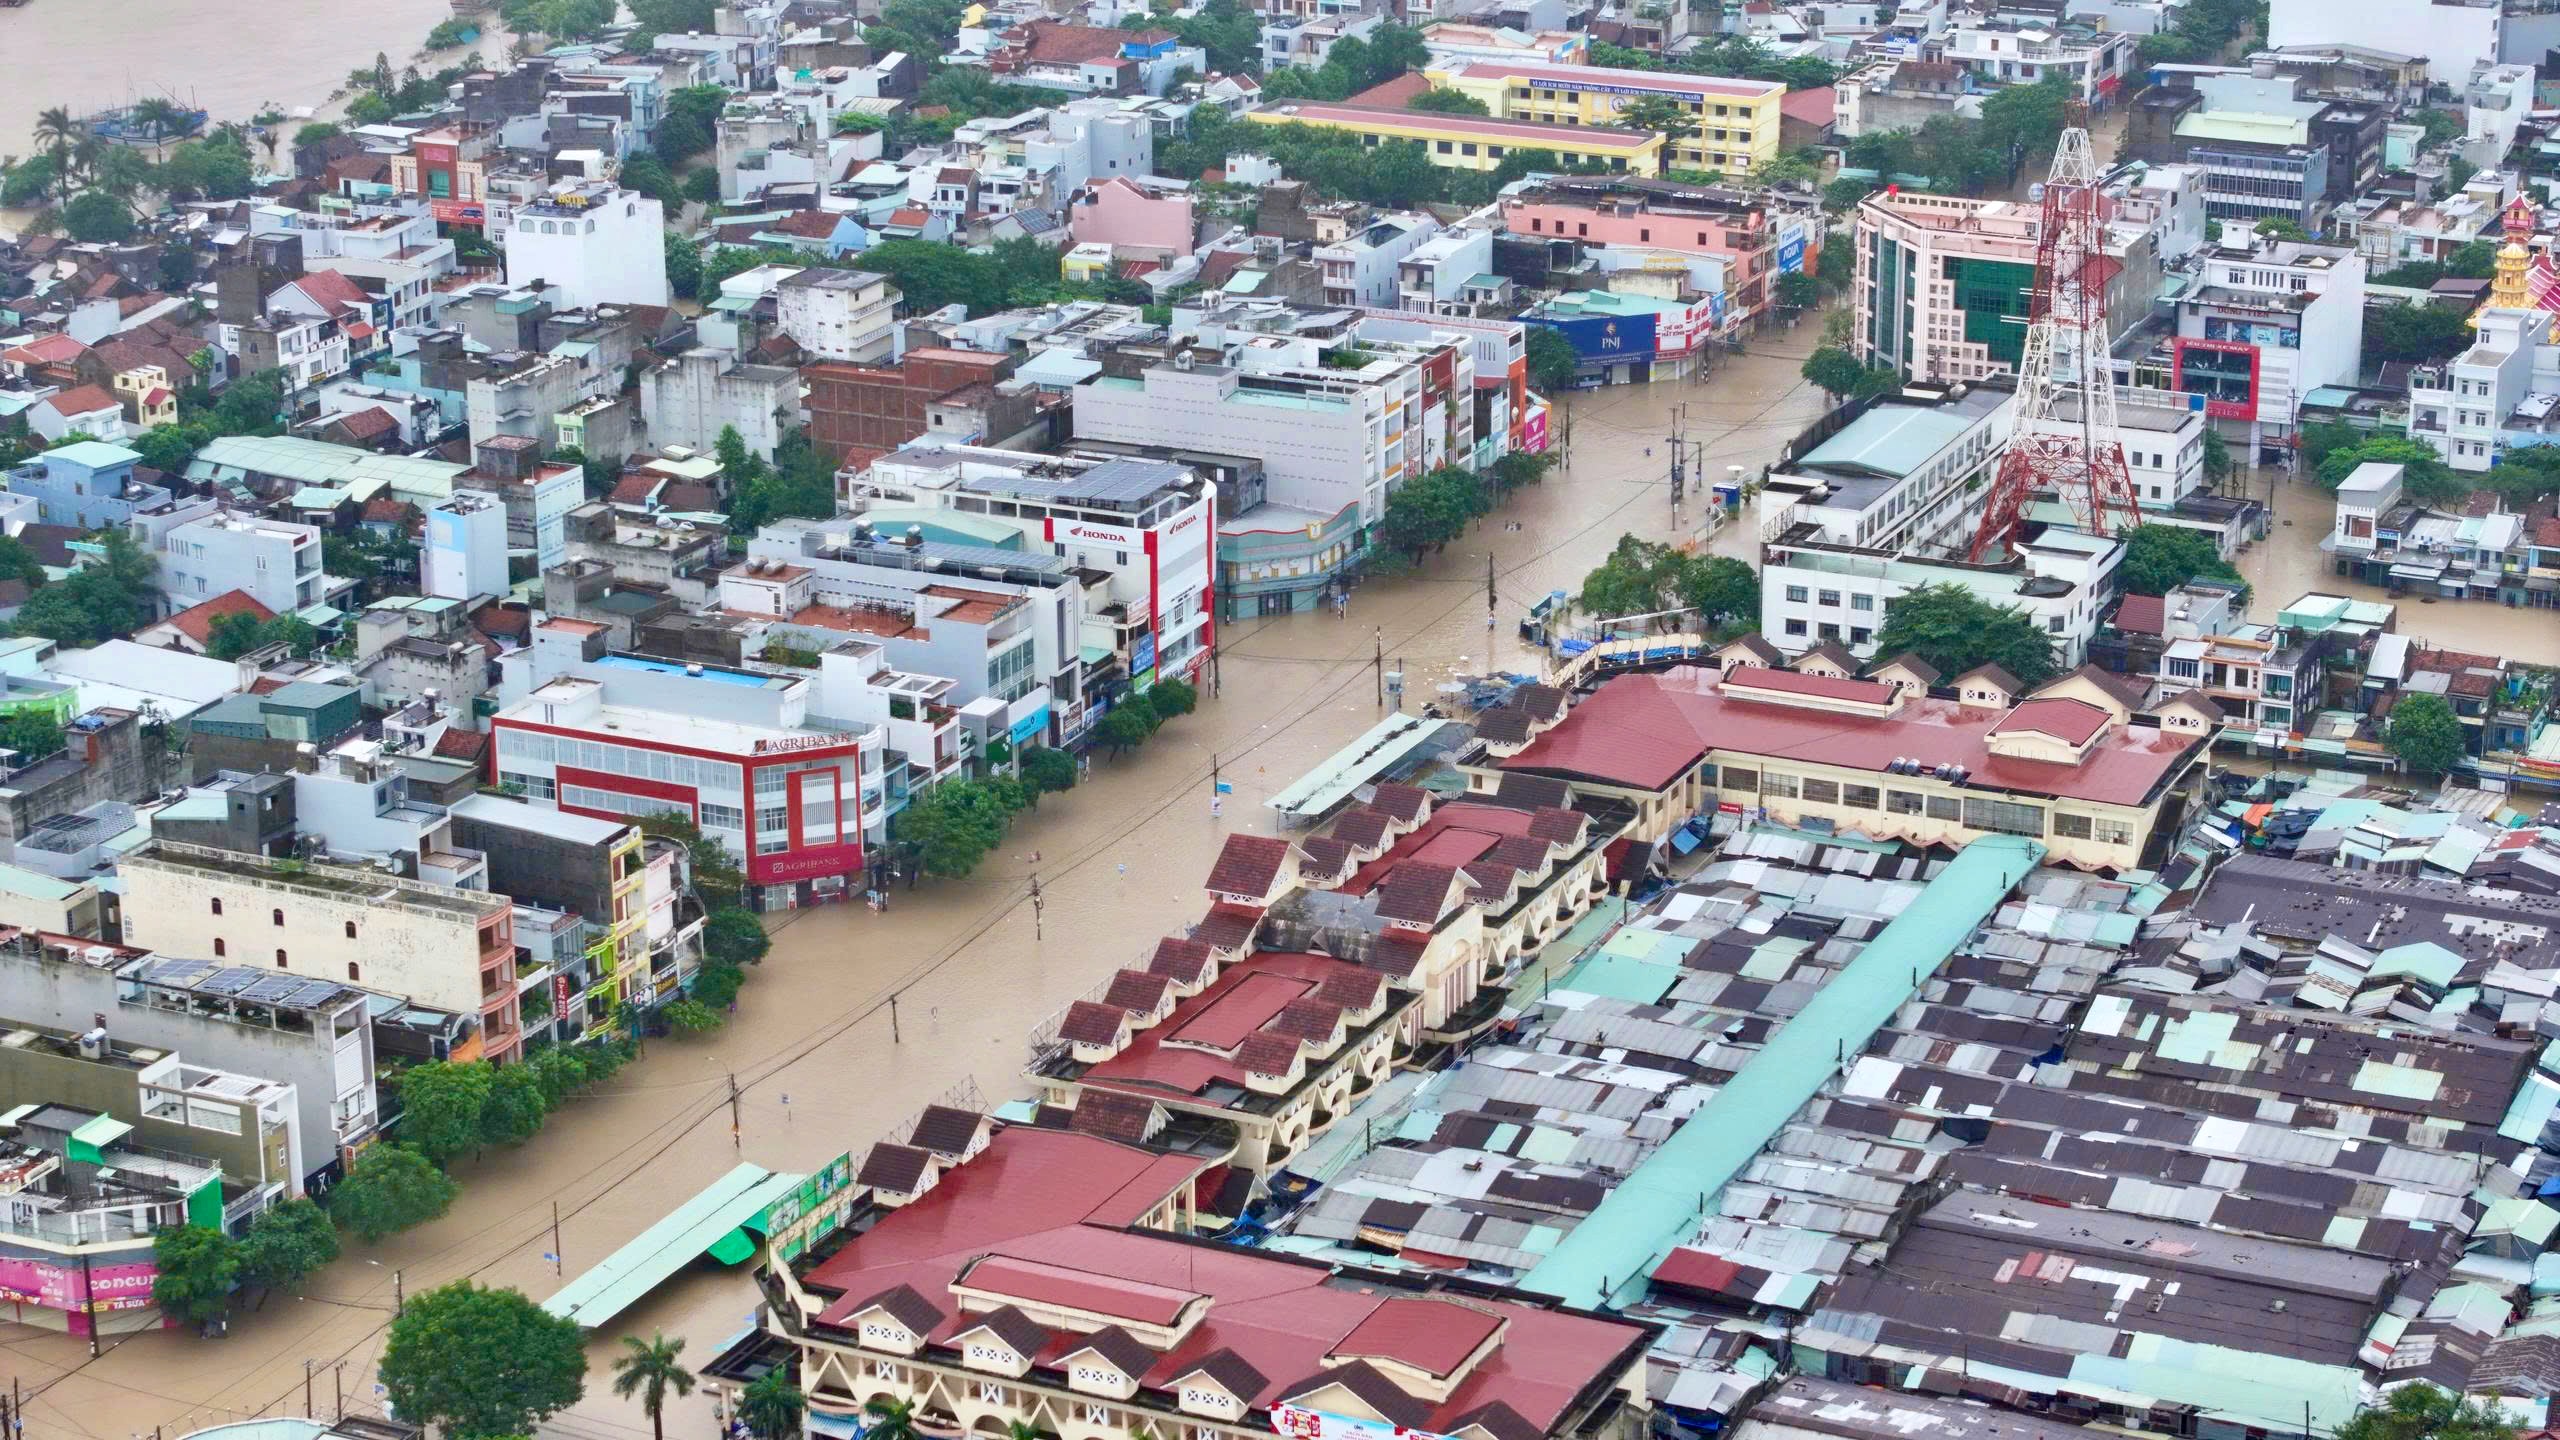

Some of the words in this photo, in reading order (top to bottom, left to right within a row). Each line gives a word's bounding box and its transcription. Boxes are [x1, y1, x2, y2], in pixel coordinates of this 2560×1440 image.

[1783, 243, 1800, 262] AQUA
[1602, 337, 1621, 349] PNJ
[1175, 514, 1197, 531] HONDA
[1083, 530, 1126, 542] HONDA
[771, 733, 851, 750] AGRIBANK
[785, 857, 840, 871] AGRIBANK
[90, 1274, 159, 1290] concun
